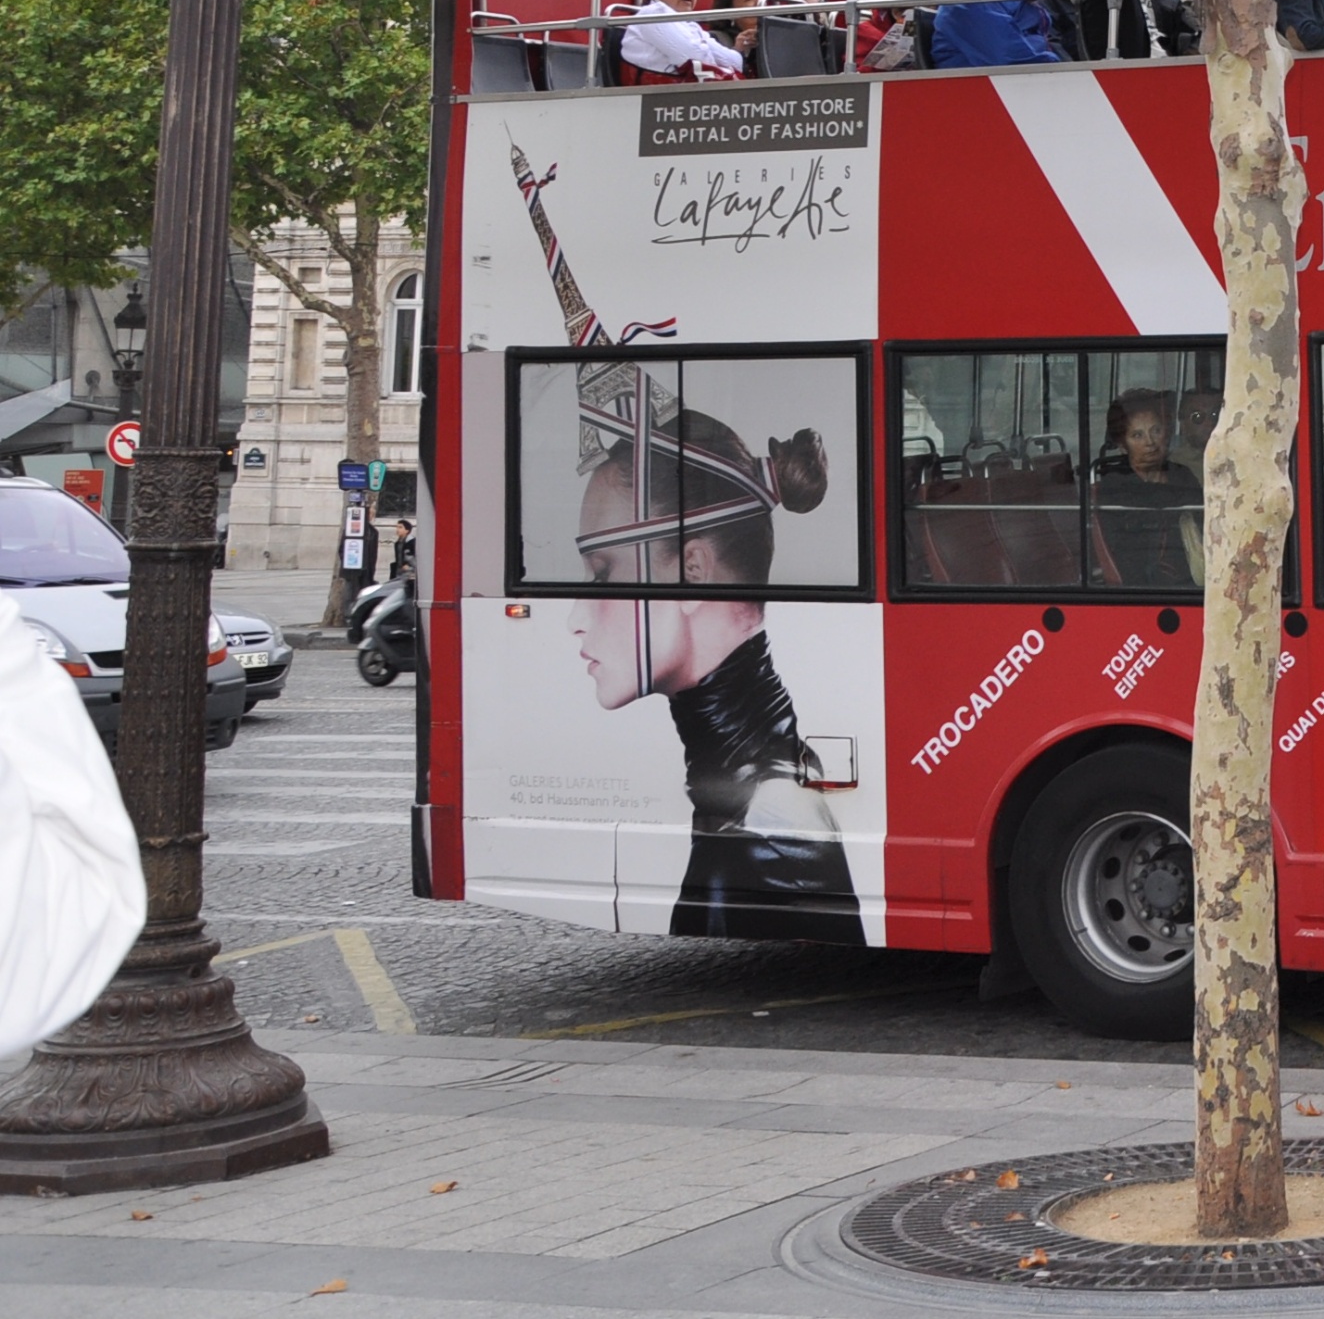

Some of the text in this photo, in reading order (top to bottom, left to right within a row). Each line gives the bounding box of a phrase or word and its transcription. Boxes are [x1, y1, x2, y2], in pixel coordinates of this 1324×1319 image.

[653, 97, 856, 123] THE DEPARTMENT STORE
[651, 126, 730, 145] CAPITAL
[737, 124, 763, 142] OF
[653, 165, 851, 187] GALERIES
[1101, 632, 1146, 683] TOUR
[1113, 643, 1165, 700] EIFFEL
[910, 628, 1046, 776] TROCADERO
[1278, 706, 1321, 755] QUAI
[529, 792, 544, 805] bd
[547, 794, 610, 807] Haussmann
[612, 795, 640, 809] Paris
